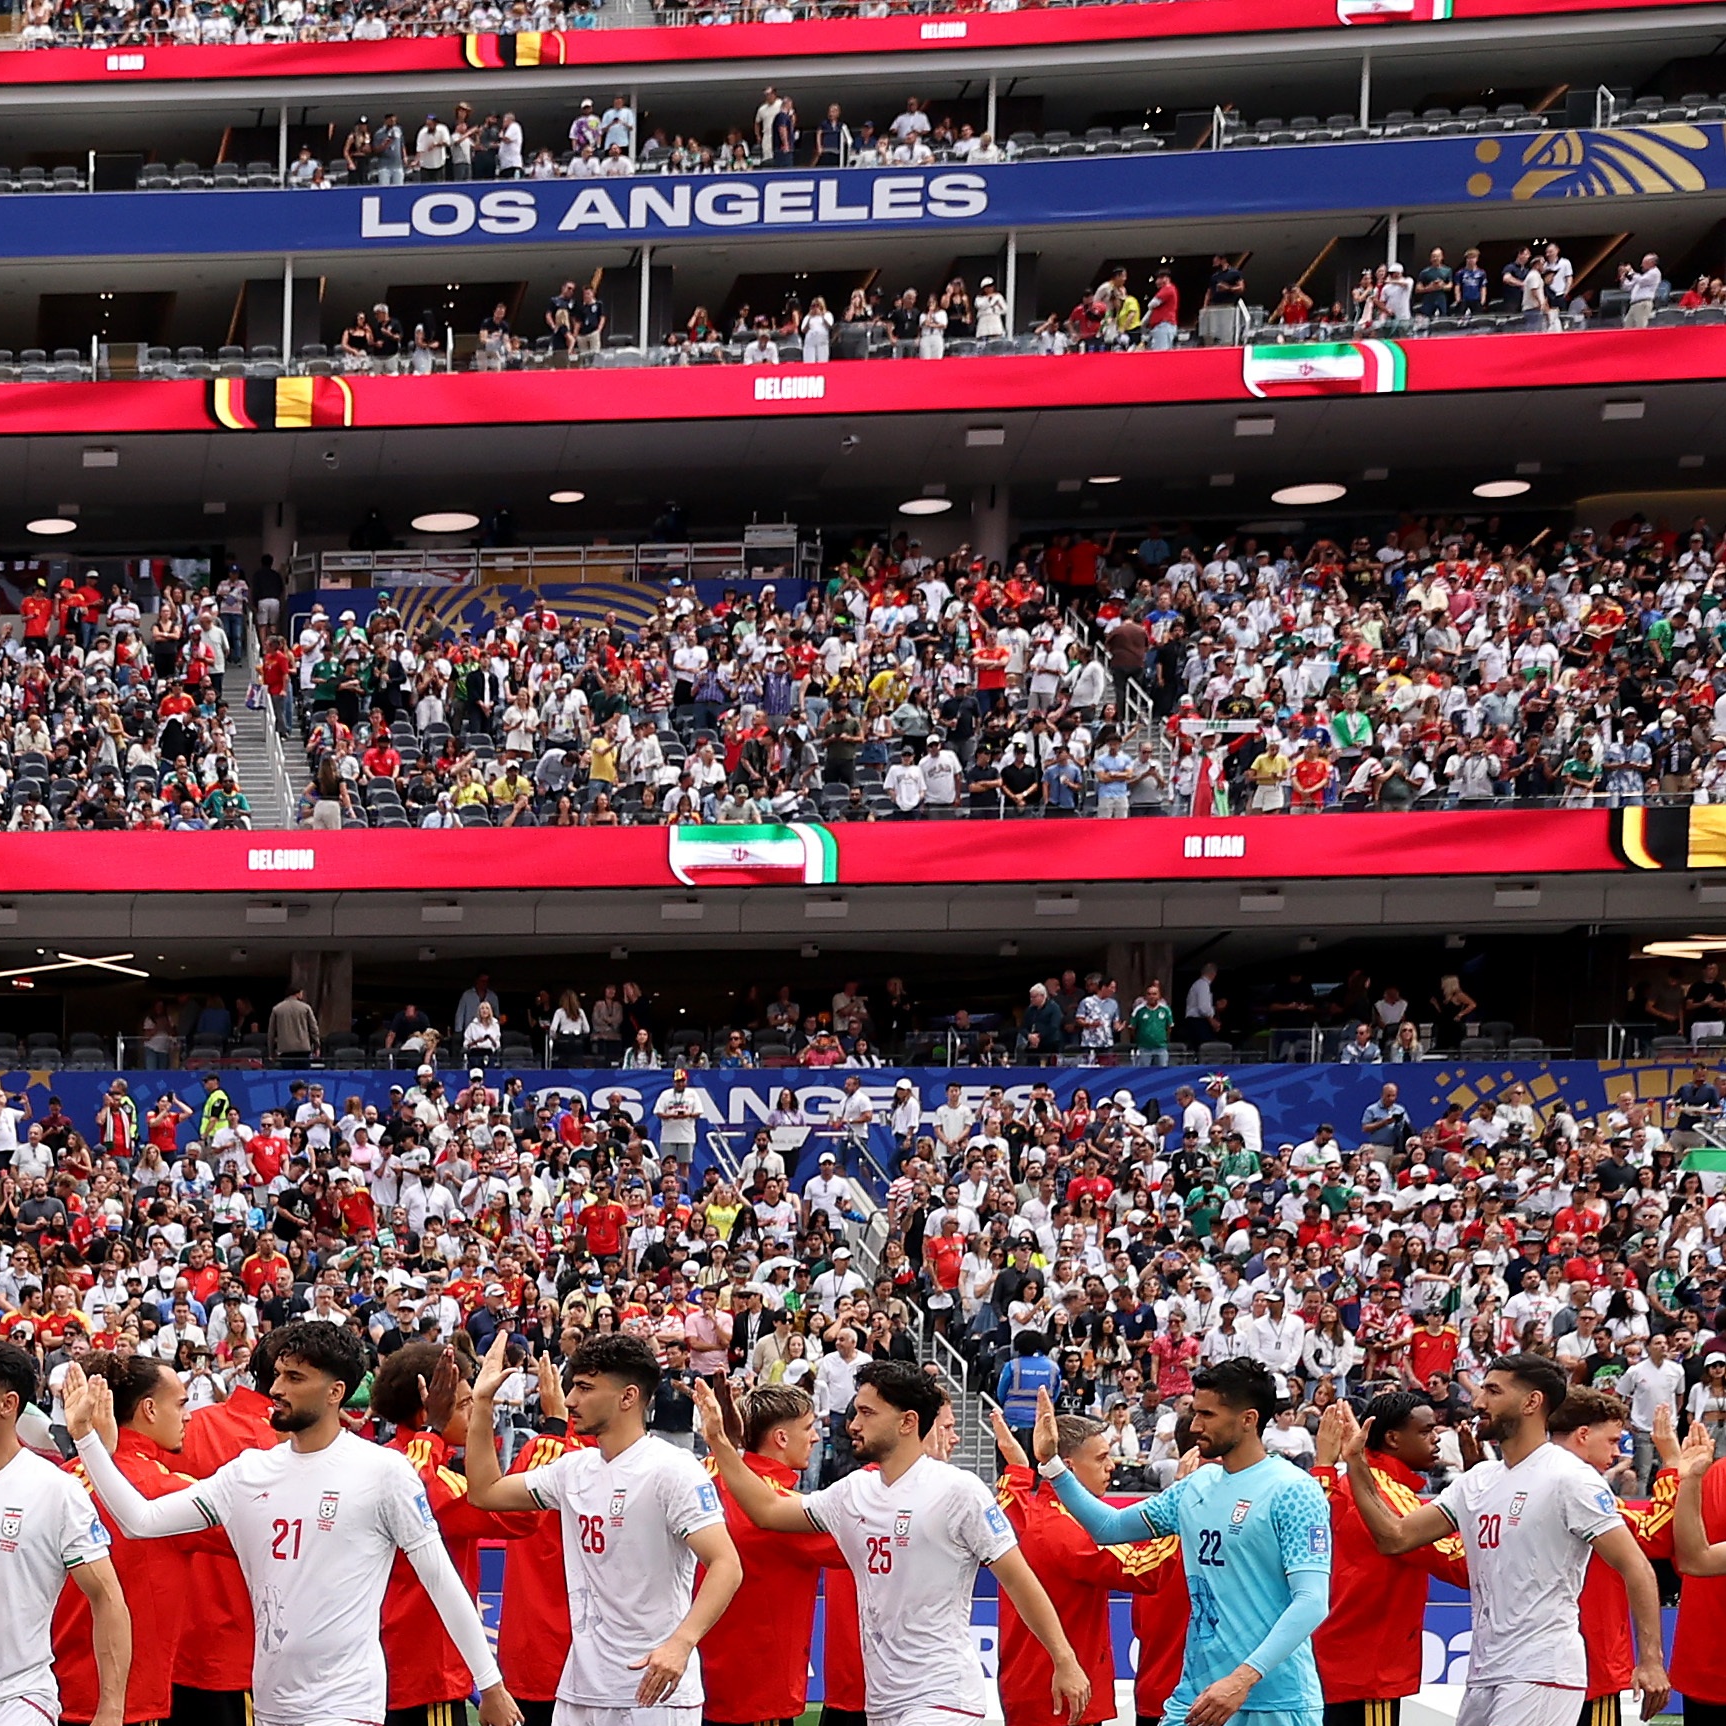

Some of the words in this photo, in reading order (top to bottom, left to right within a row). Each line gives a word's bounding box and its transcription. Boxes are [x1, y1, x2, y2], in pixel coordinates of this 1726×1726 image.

[920, 22, 967, 40] BELGIUM
[360, 191, 537, 238] LOS
[557, 173, 989, 232] ANGELES
[755, 376, 825, 400] BELGIUM
[248, 849, 315, 871] BELGIUM
[1185, 837, 1203, 858] IR
[1203, 836, 1245, 858] IRAN
[271, 1518, 302, 1560] 21
[578, 1515, 605, 1554] 26
[1197, 1529, 1225, 1567] 22
[1478, 1514, 1501, 1549] 20
[866, 1536, 892, 1575] 25
